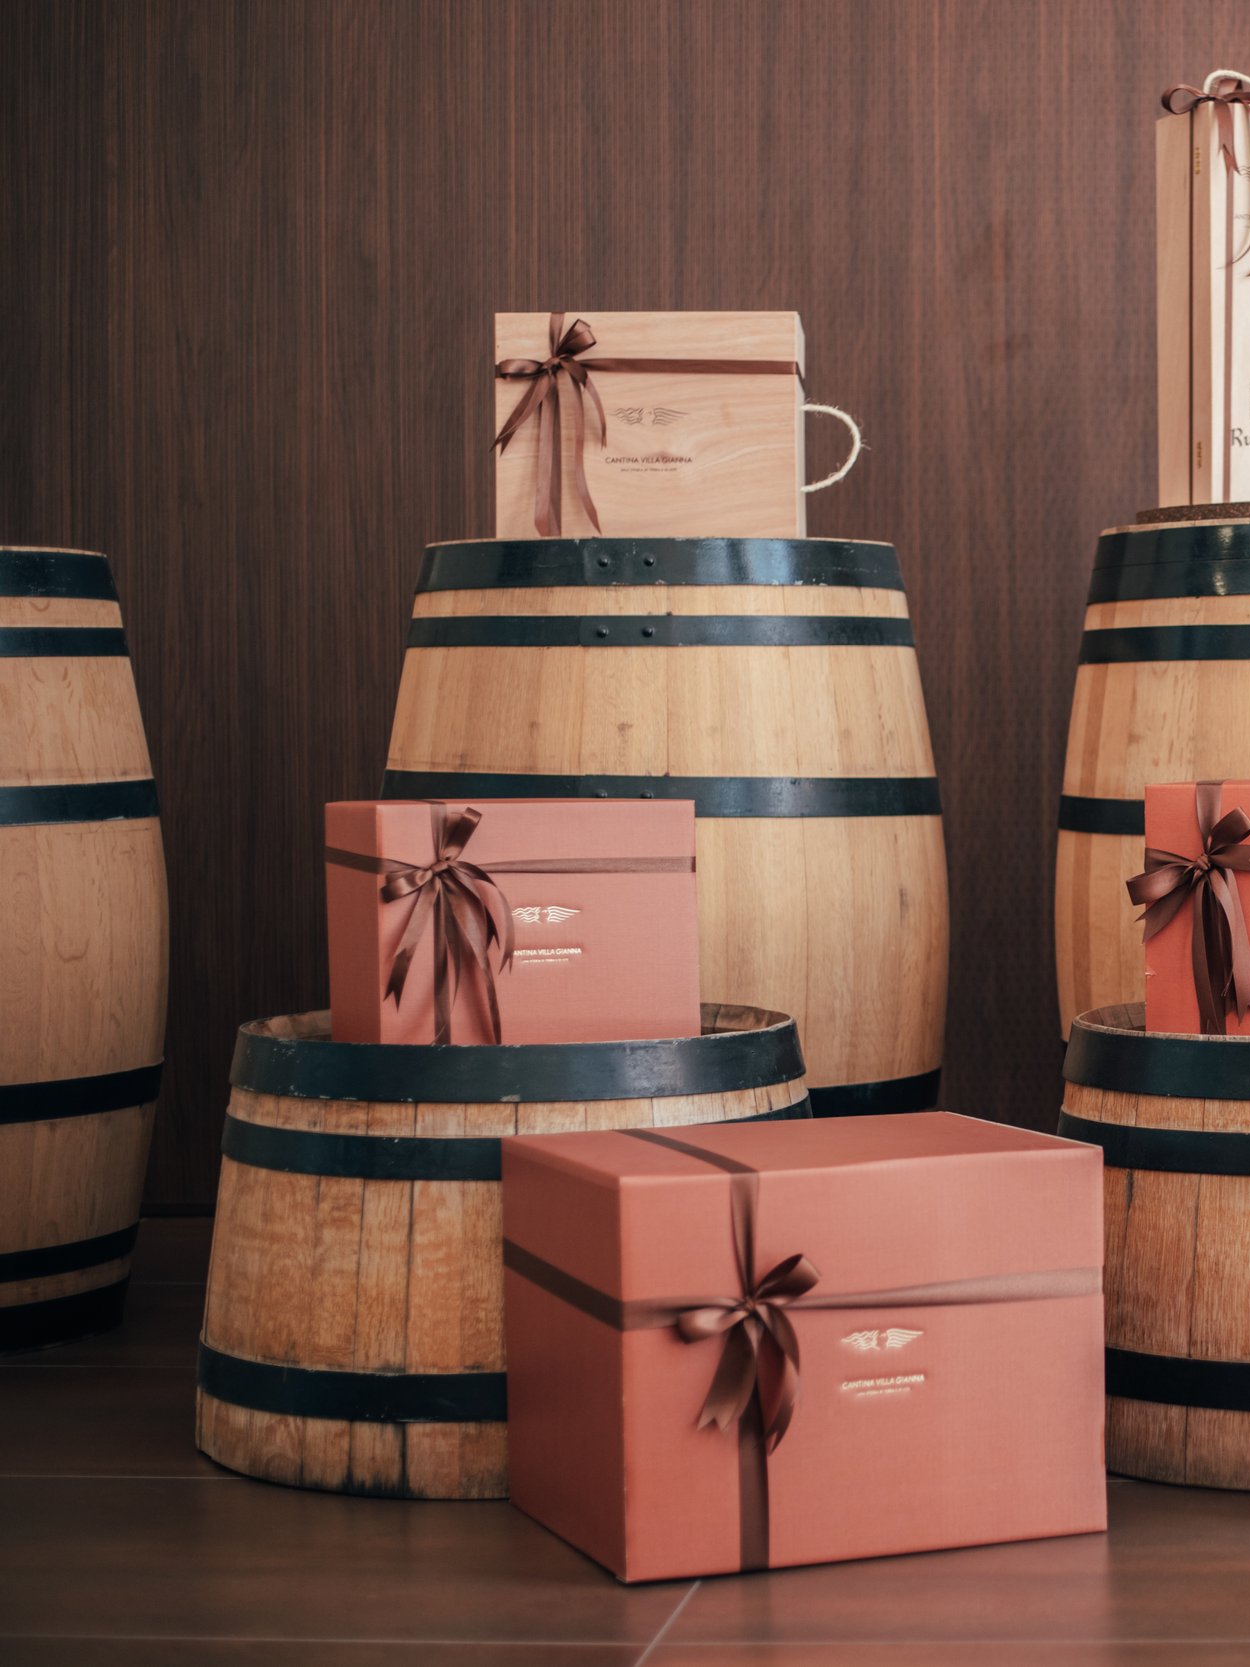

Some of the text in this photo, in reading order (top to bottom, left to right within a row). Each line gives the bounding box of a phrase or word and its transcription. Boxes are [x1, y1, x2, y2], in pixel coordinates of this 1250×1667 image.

[661, 456, 693, 464] GIANNA
[556, 947, 582, 955] GIANNA
[841, 1374, 925, 1390] CANTINA VILLA GIANNA
